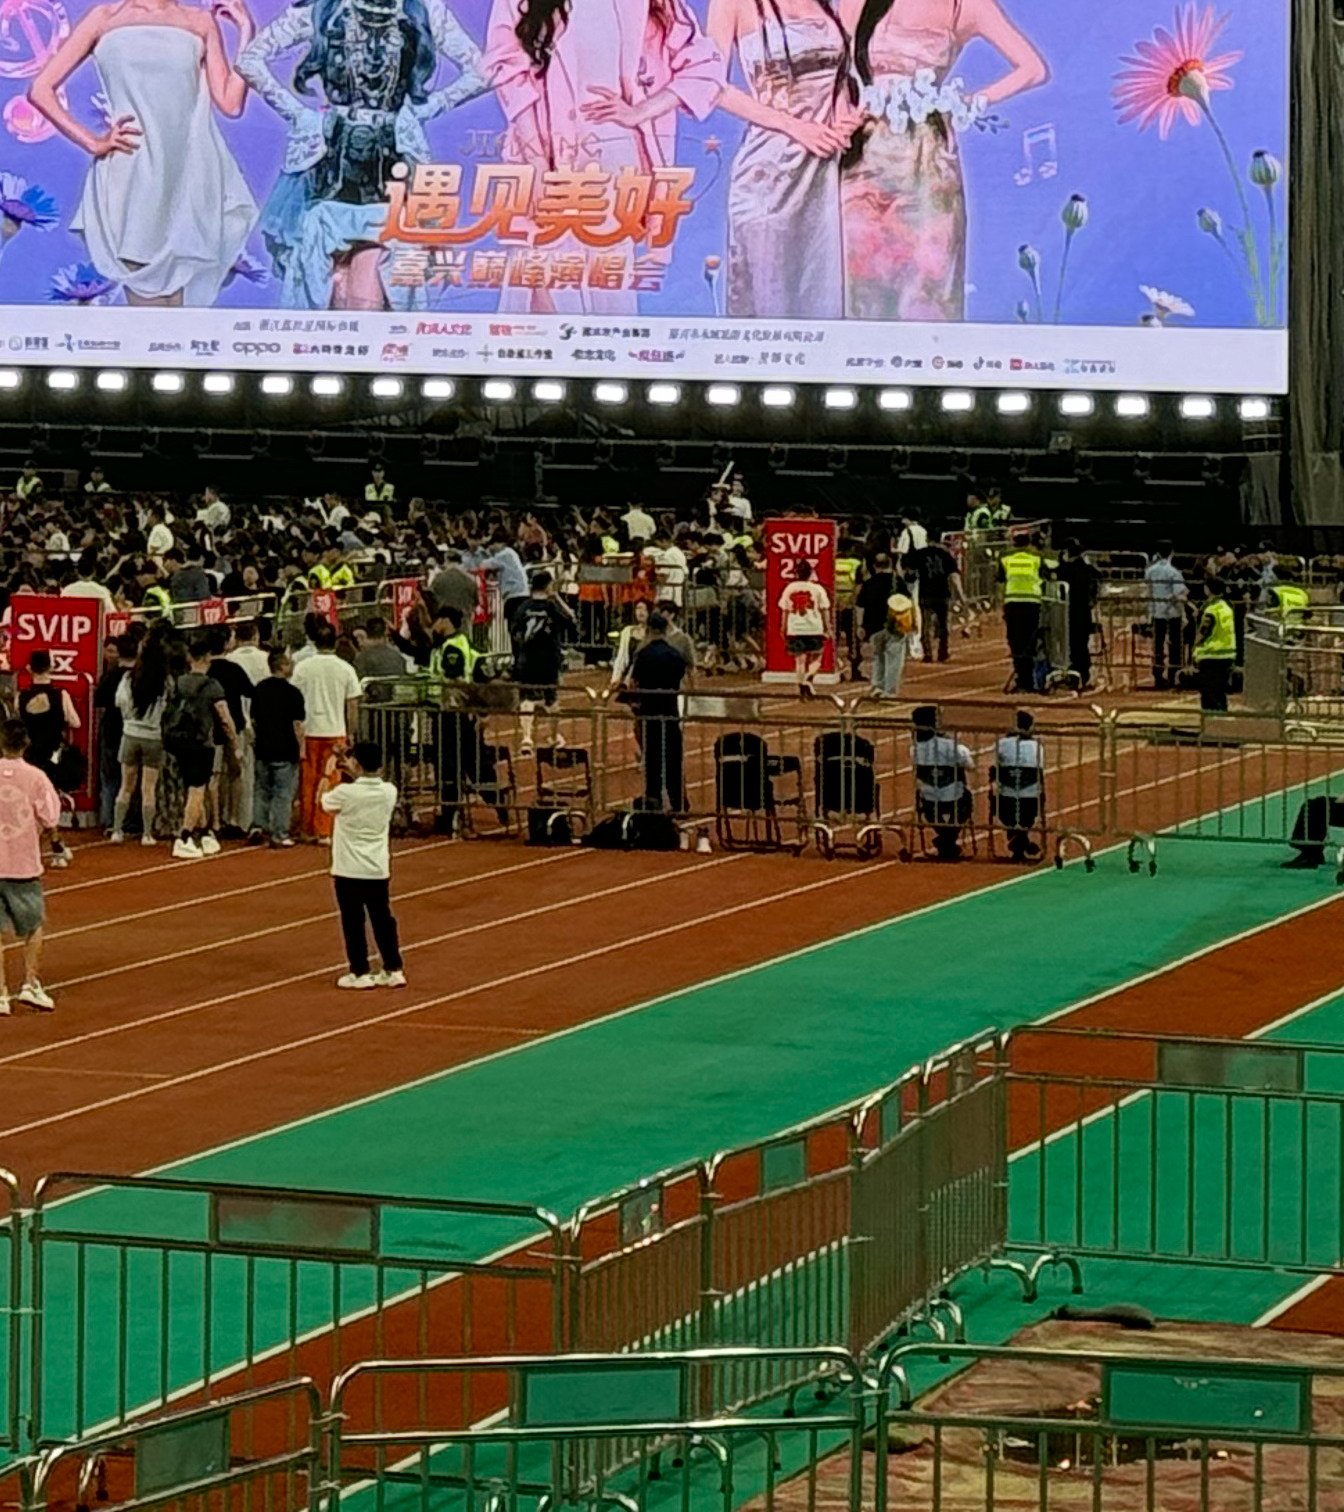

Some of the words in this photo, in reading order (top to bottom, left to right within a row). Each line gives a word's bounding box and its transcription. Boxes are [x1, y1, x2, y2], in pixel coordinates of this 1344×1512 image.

[380, 161, 697, 247] 遇见美好
[389, 248, 669, 292] 嘉兴巅峰演唱会
[771, 533, 829, 555] SVIP
[17, 614, 91, 642] SVIP
